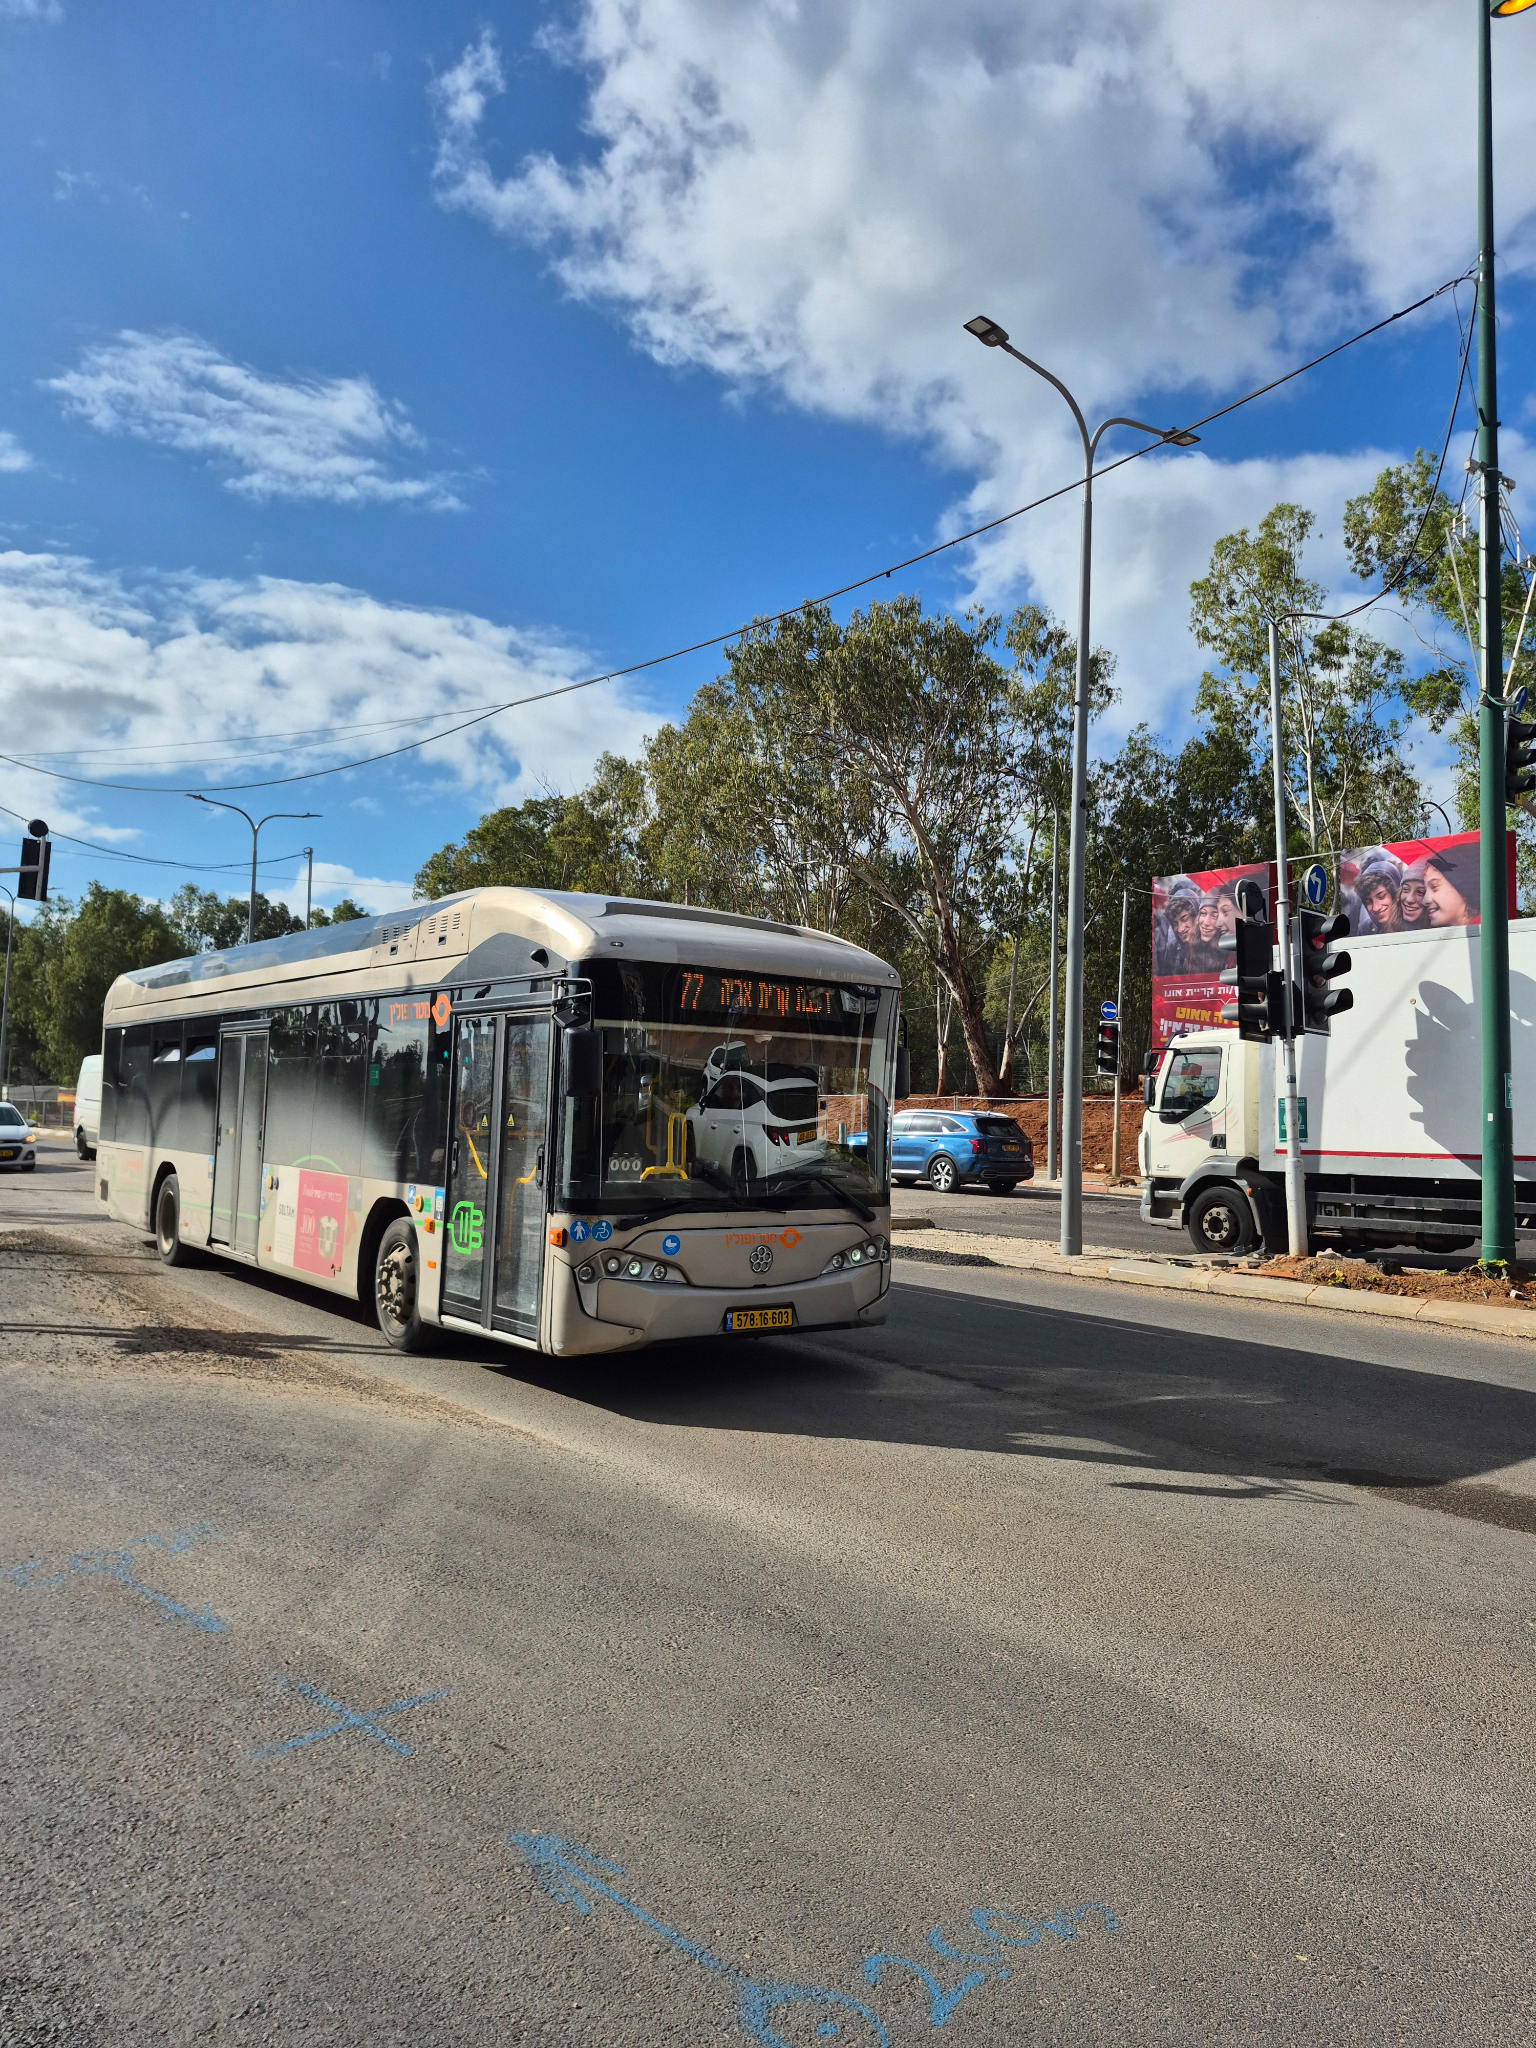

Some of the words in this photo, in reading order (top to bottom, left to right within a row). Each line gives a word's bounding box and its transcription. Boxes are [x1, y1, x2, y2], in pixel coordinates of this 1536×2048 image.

[681, 972, 704, 1010] 77
[720, 977, 753, 1008] אריה
[1164, 989, 1183, 998] אונו
[1186, 987, 1214, 998] קריית
[1175, 1006, 1212, 1023] אאוט
[725, 1232, 778, 1249] מטרופולין
